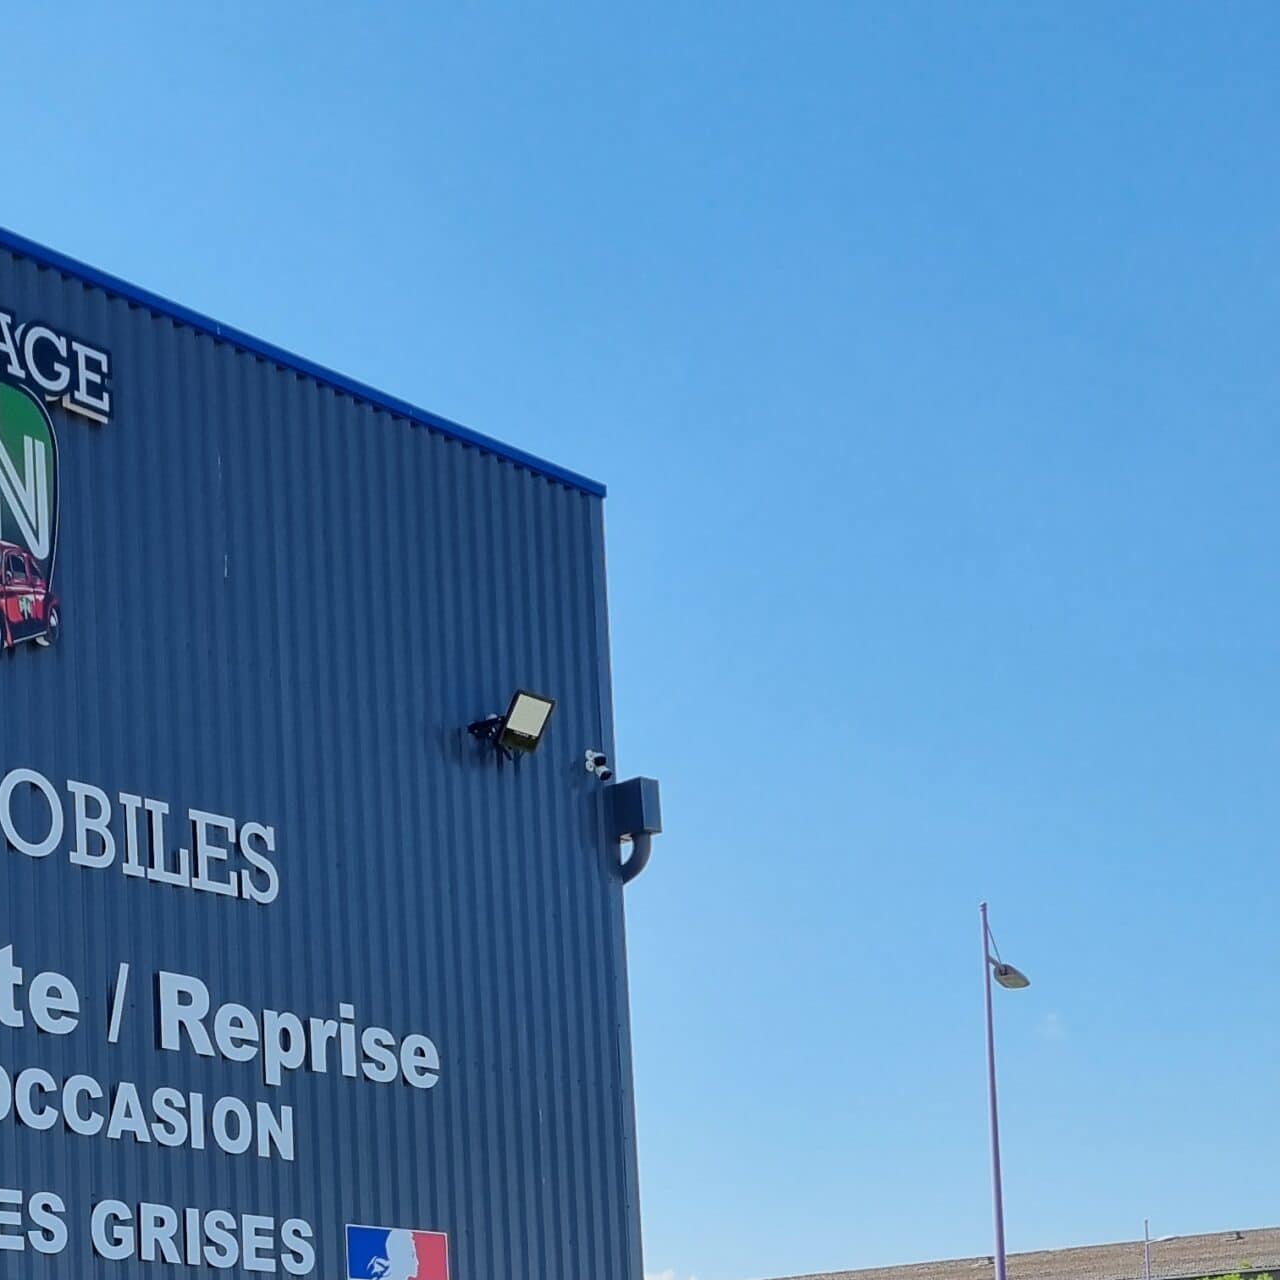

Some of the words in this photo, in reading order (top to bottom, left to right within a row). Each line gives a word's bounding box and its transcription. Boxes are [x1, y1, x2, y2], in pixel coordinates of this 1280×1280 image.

[107, 962, 129, 1043] /
[158, 970, 441, 1089] Reprise
[91, 1199, 316, 1276] GRISES
